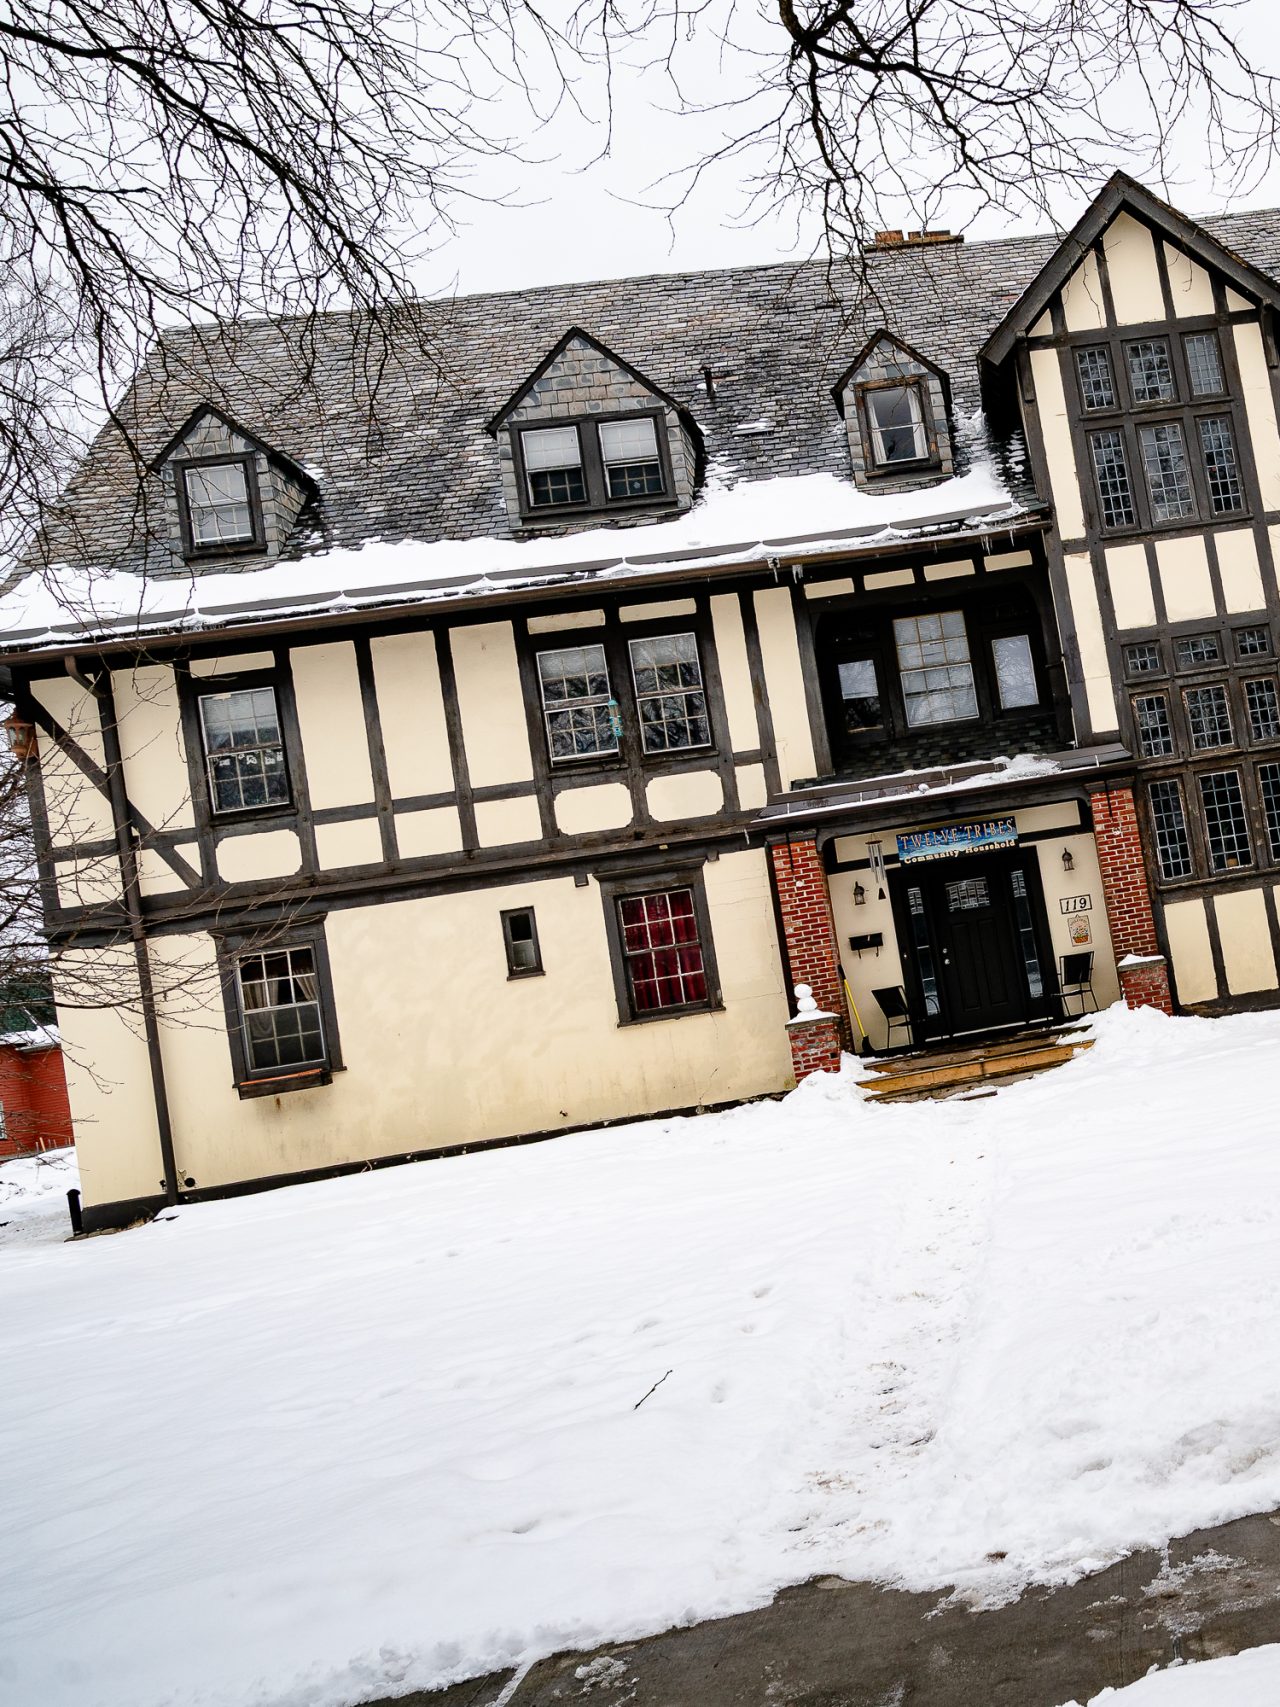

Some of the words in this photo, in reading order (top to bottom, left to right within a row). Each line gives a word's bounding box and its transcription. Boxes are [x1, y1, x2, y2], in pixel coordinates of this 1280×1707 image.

[900, 828, 959, 850] TWELVE
[963, 819, 1014, 840] TRIBES
[903, 849, 960, 865] Community
[964, 838, 1016, 854] Household
[1065, 897, 1087, 912] 119
